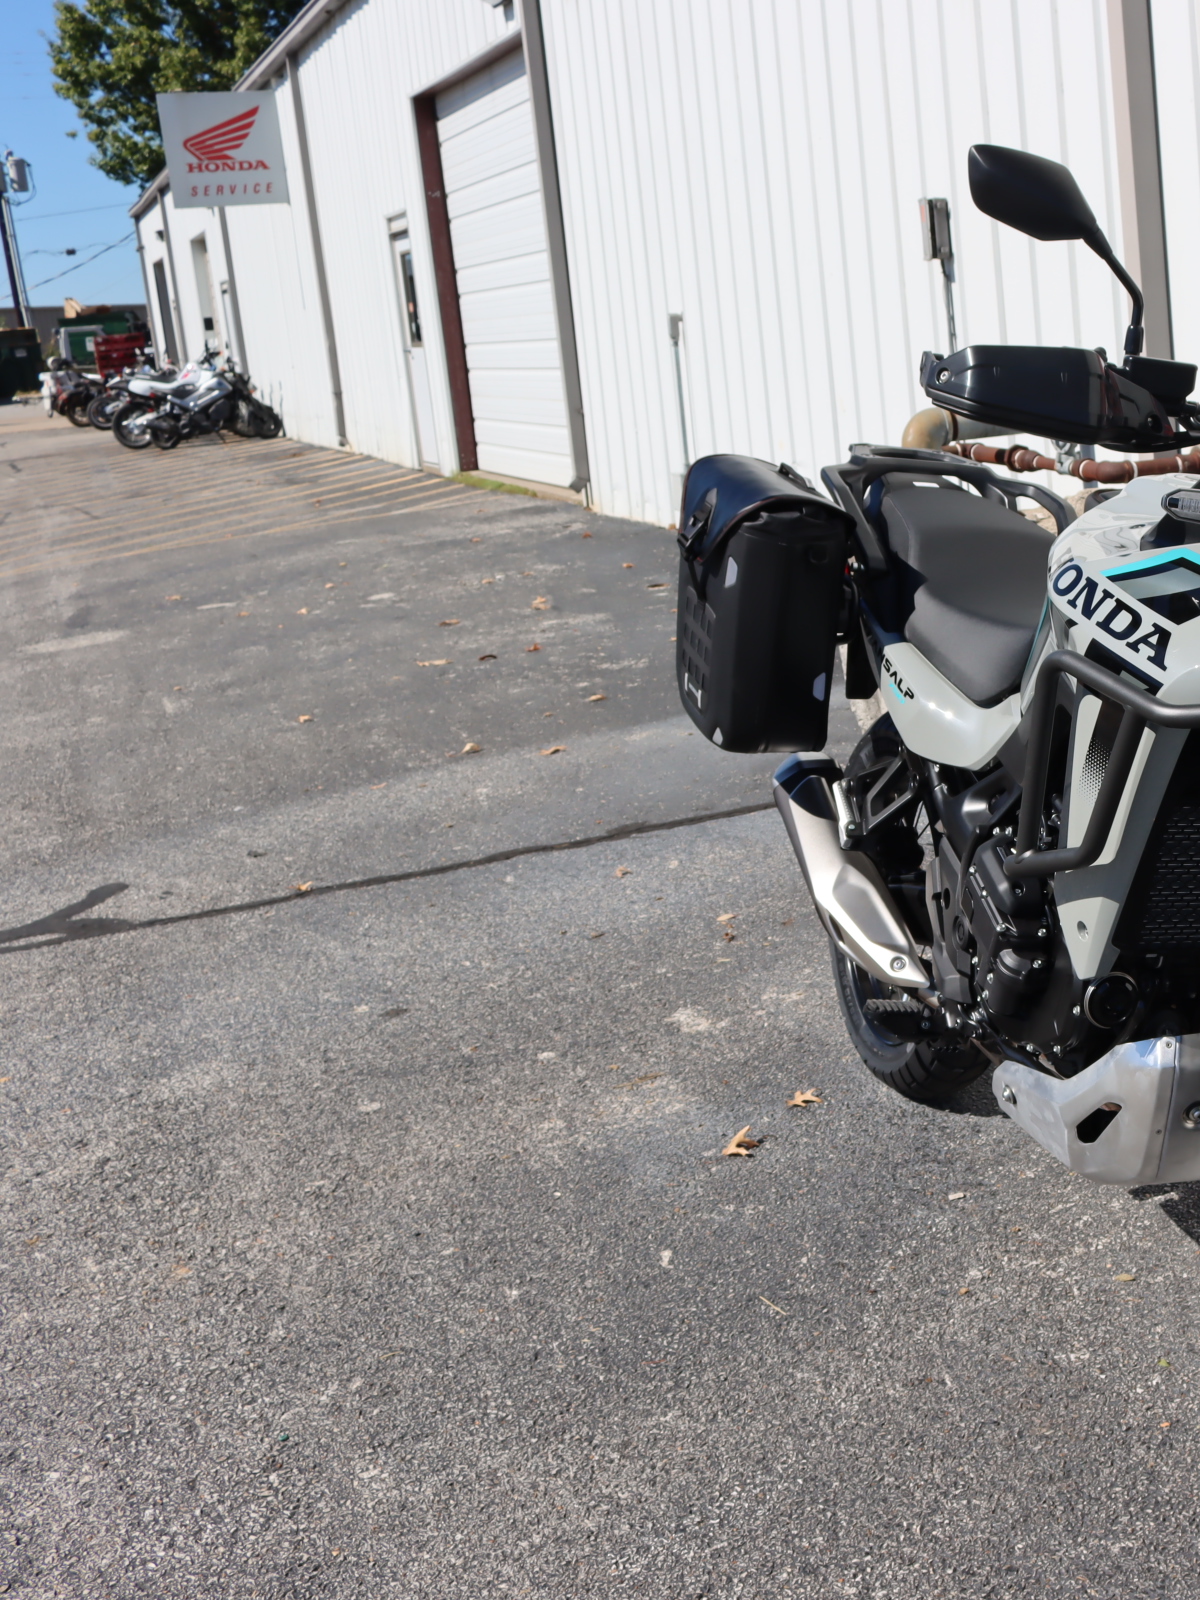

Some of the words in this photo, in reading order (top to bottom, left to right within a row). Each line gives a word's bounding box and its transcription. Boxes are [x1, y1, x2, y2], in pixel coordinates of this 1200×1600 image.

[186, 160, 270, 173] HONDA
[191, 182, 273, 197] SERVICE
[1050, 557, 1172, 672] ONDA
